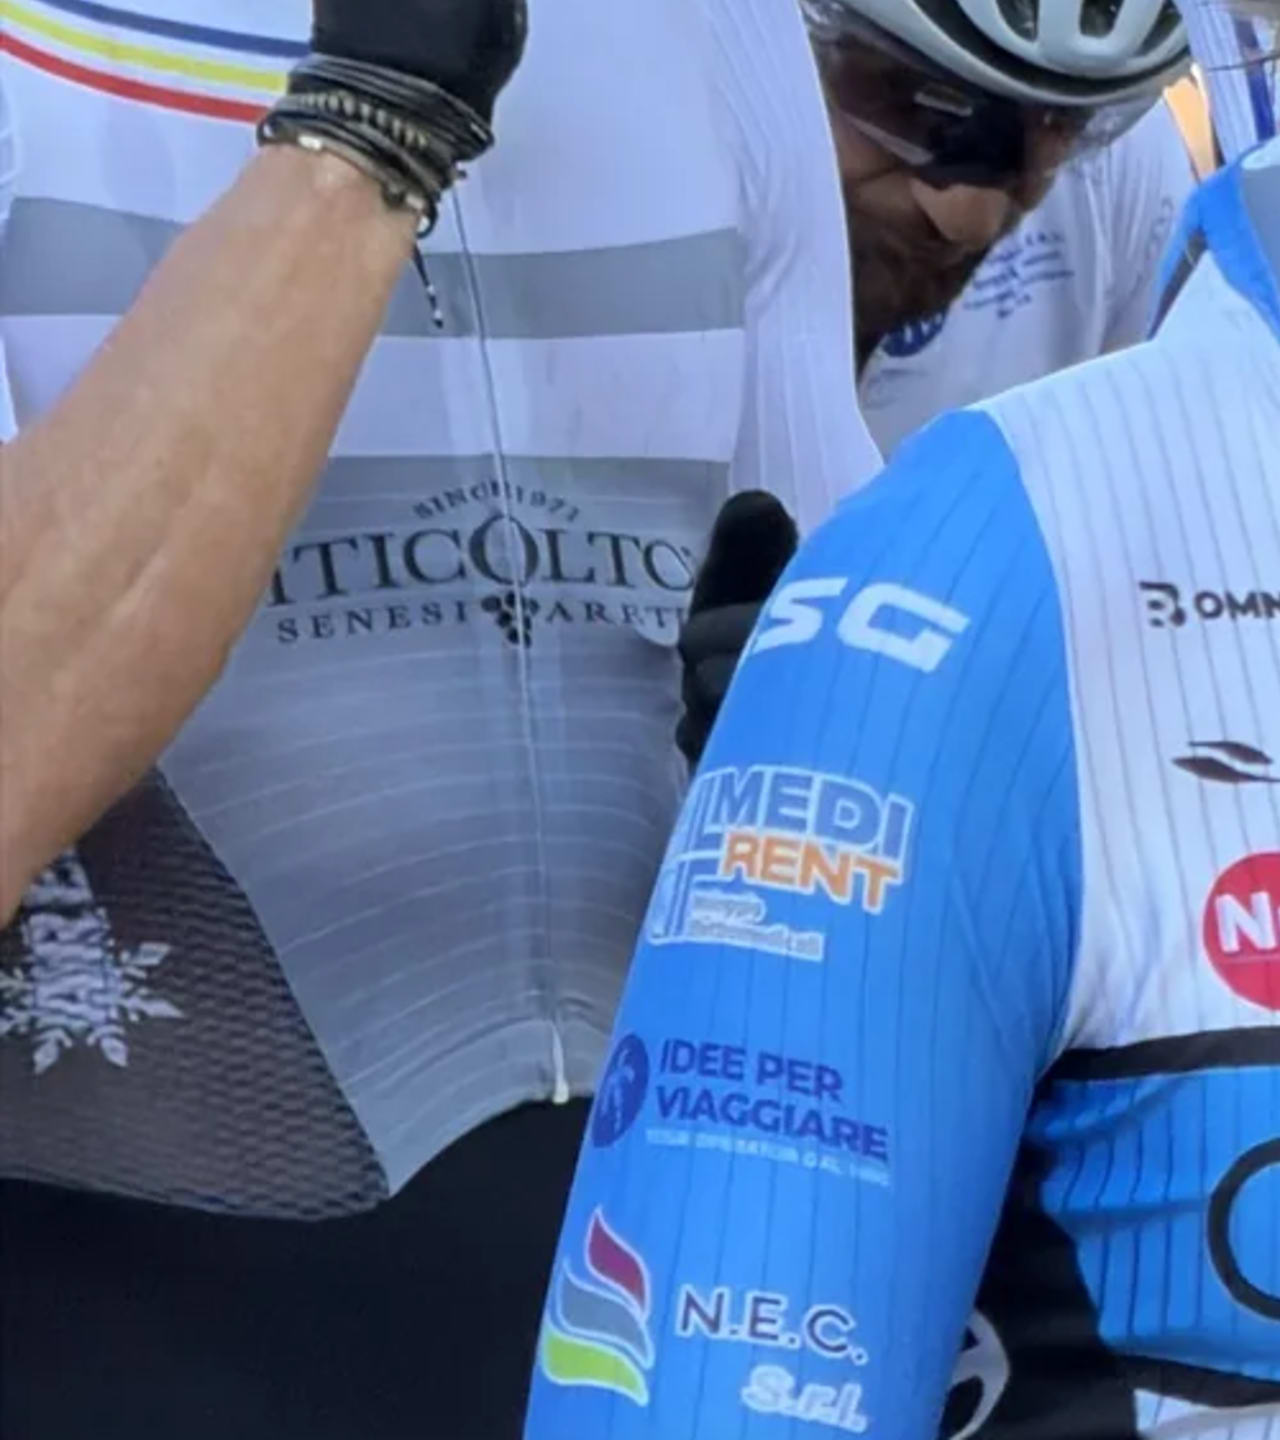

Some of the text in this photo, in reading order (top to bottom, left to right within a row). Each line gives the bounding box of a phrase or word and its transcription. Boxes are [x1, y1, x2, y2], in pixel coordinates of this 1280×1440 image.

[277, 601, 468, 644] SENESI
[703, 765, 914, 864] MEDI
[719, 830, 903, 915] RENT
[659, 1038, 843, 1105] IDEE PER
[656, 1084, 891, 1164] VIAGGIARE
[676, 1284, 869, 1367] N.E.C.
